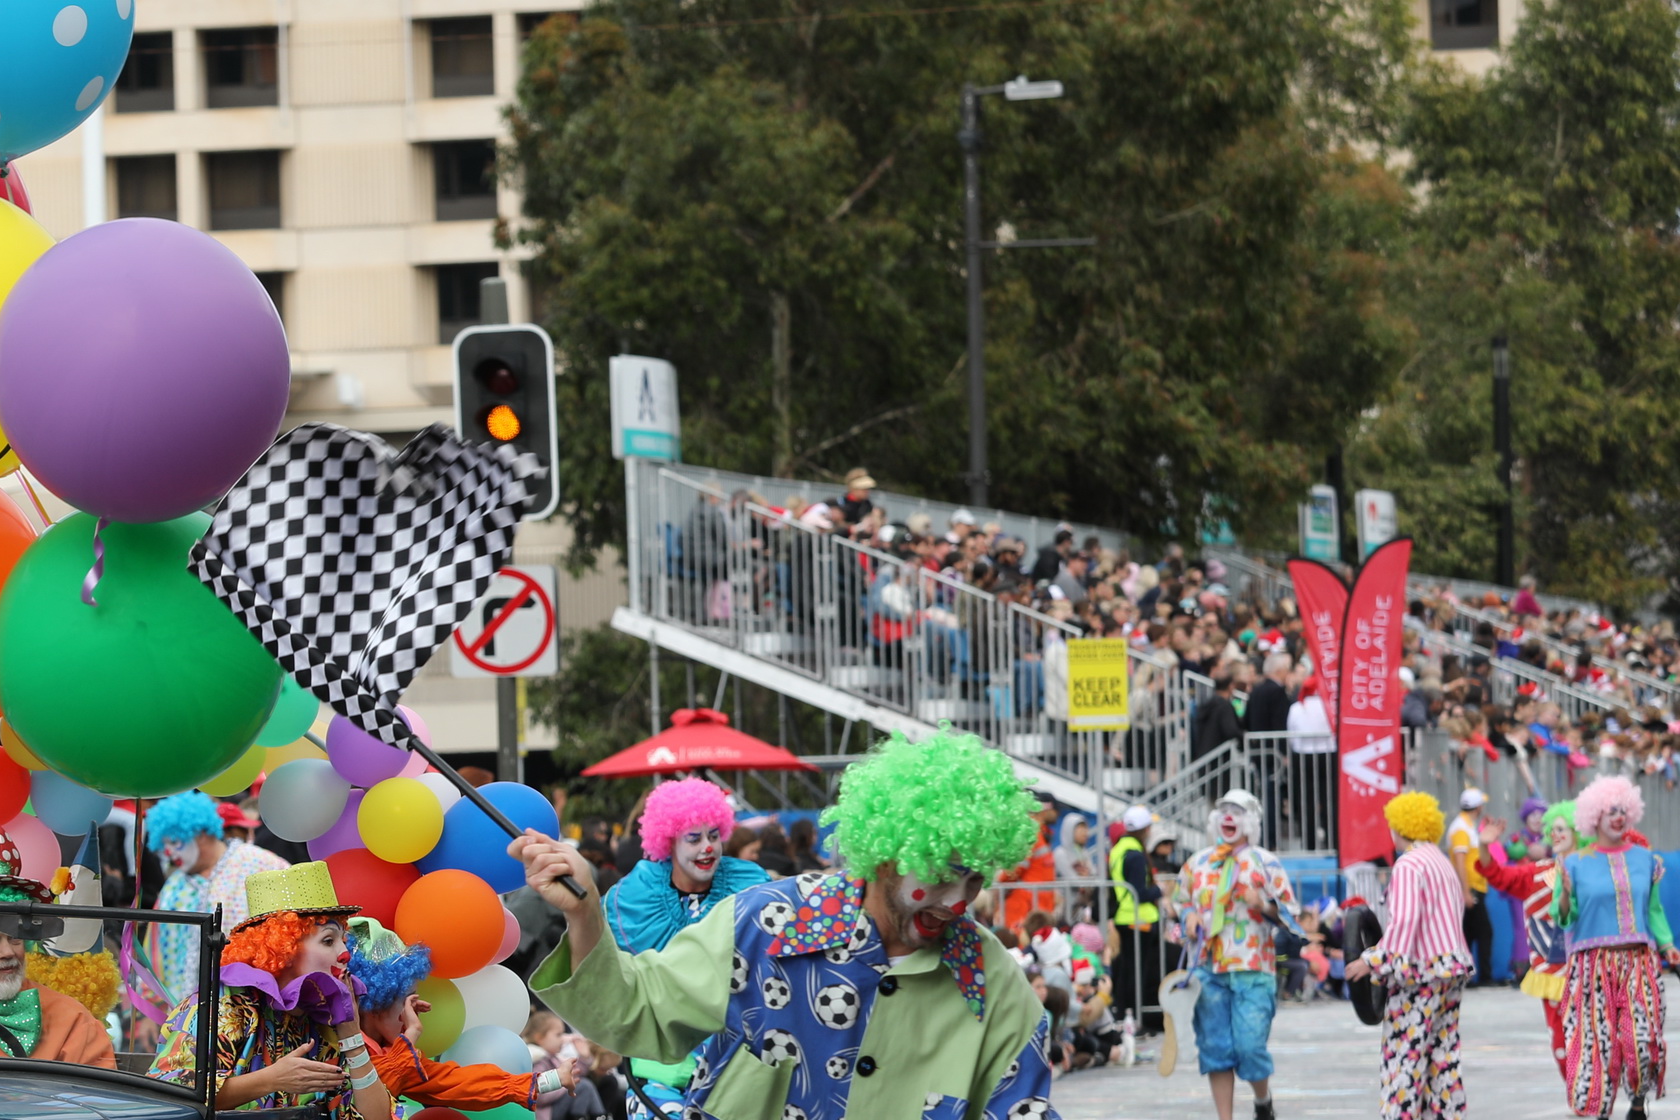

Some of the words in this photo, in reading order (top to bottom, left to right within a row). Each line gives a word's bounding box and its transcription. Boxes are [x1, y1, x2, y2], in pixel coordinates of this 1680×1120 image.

[1355, 617, 1371, 650] OF
[1369, 594, 1393, 712] ADELAIDE
[1073, 678, 1120, 691] KEEP
[1073, 692, 1122, 707] CLEAR
[1351, 657, 1369, 710] CITY
